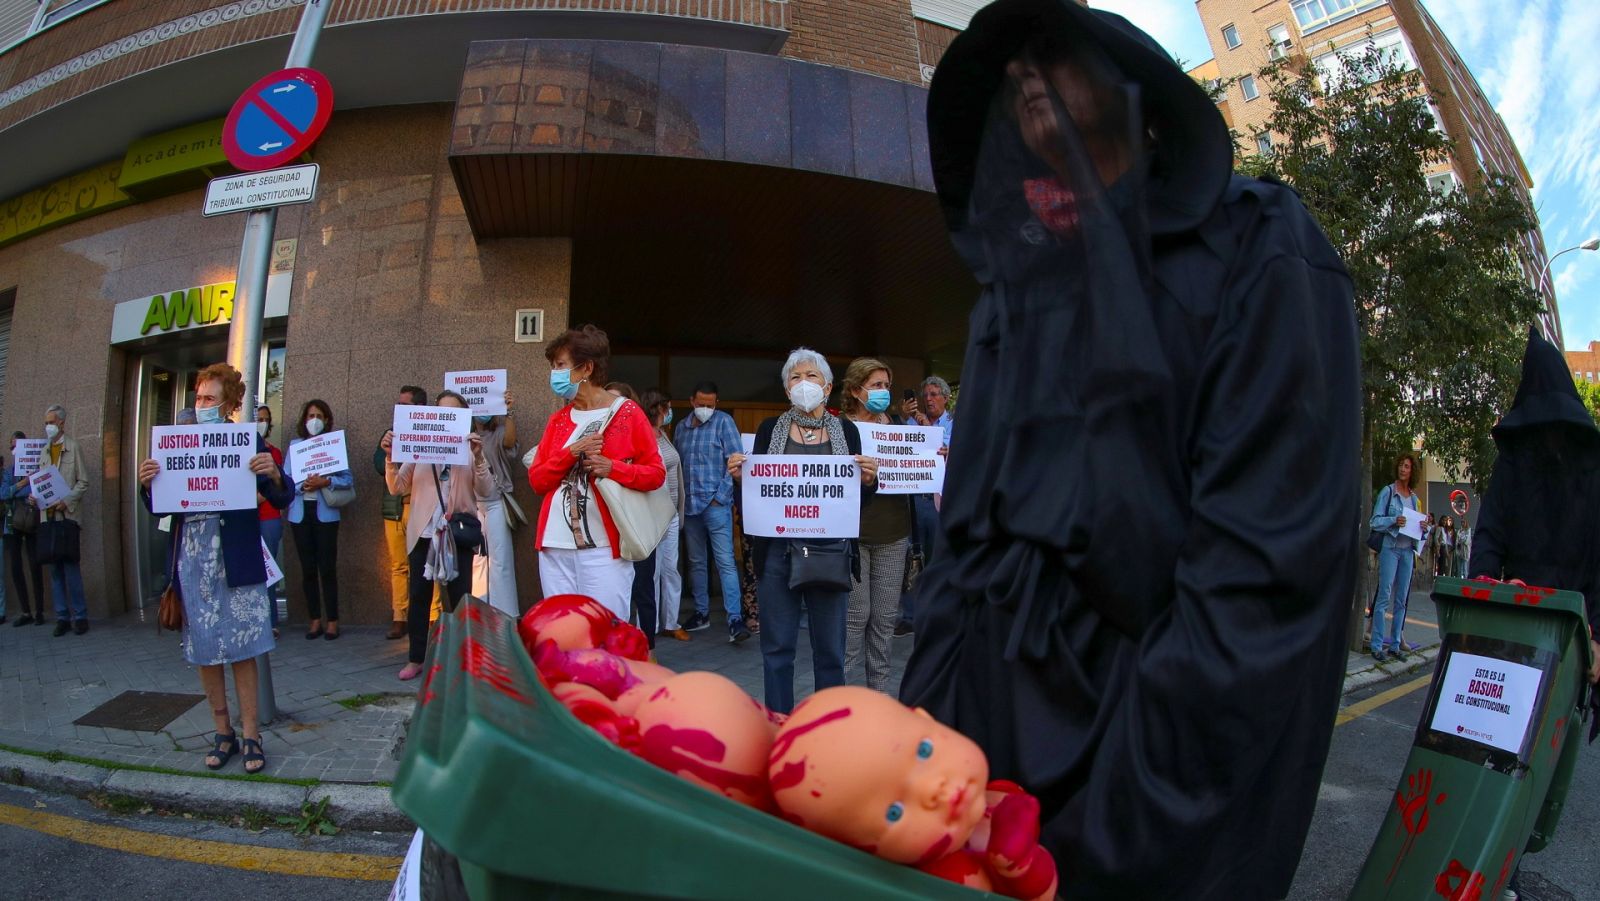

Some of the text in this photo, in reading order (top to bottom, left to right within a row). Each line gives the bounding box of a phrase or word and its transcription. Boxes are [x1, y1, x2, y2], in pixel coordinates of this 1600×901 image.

[225, 172, 300, 191] ZONA DE SEGURIDAD
[209, 187, 311, 209] TRIBUNAL CONSTITUCIONAL
[140, 282, 236, 335] AMIR
[521, 315, 537, 336] 11
[454, 375, 496, 385] MAGISTRADOS:
[460, 386, 488, 395] DÉJENLOS
[409, 412, 456, 421] 1.025.000 BEBÉS
[158, 432, 250, 449] JUSTICIA PARA LOS
[399, 433, 463, 444] ESPERANDO SENTENCIA
[872, 431, 926, 442] 1.025.000 BEBÉS
[401, 445, 458, 454] DEL CONSTITUCIONAL
[166, 452, 241, 470] BEBÉS AÚN POR
[900, 459, 936, 468] SENTENCIA
[750, 464, 854, 478] JUSTICIA PARA LOS
[879, 472, 934, 481] CONSTITUCIONAL
[187, 476, 219, 491] NACER
[761, 481, 844, 498] BEBÉS AÚN POR
[784, 505, 819, 518] NACER
[1475, 668, 1506, 682] ESTA ES LA
[1468, 679, 1504, 699] BASURA
[1454, 694, 1511, 715] DEL CONSTITUCIONAL
